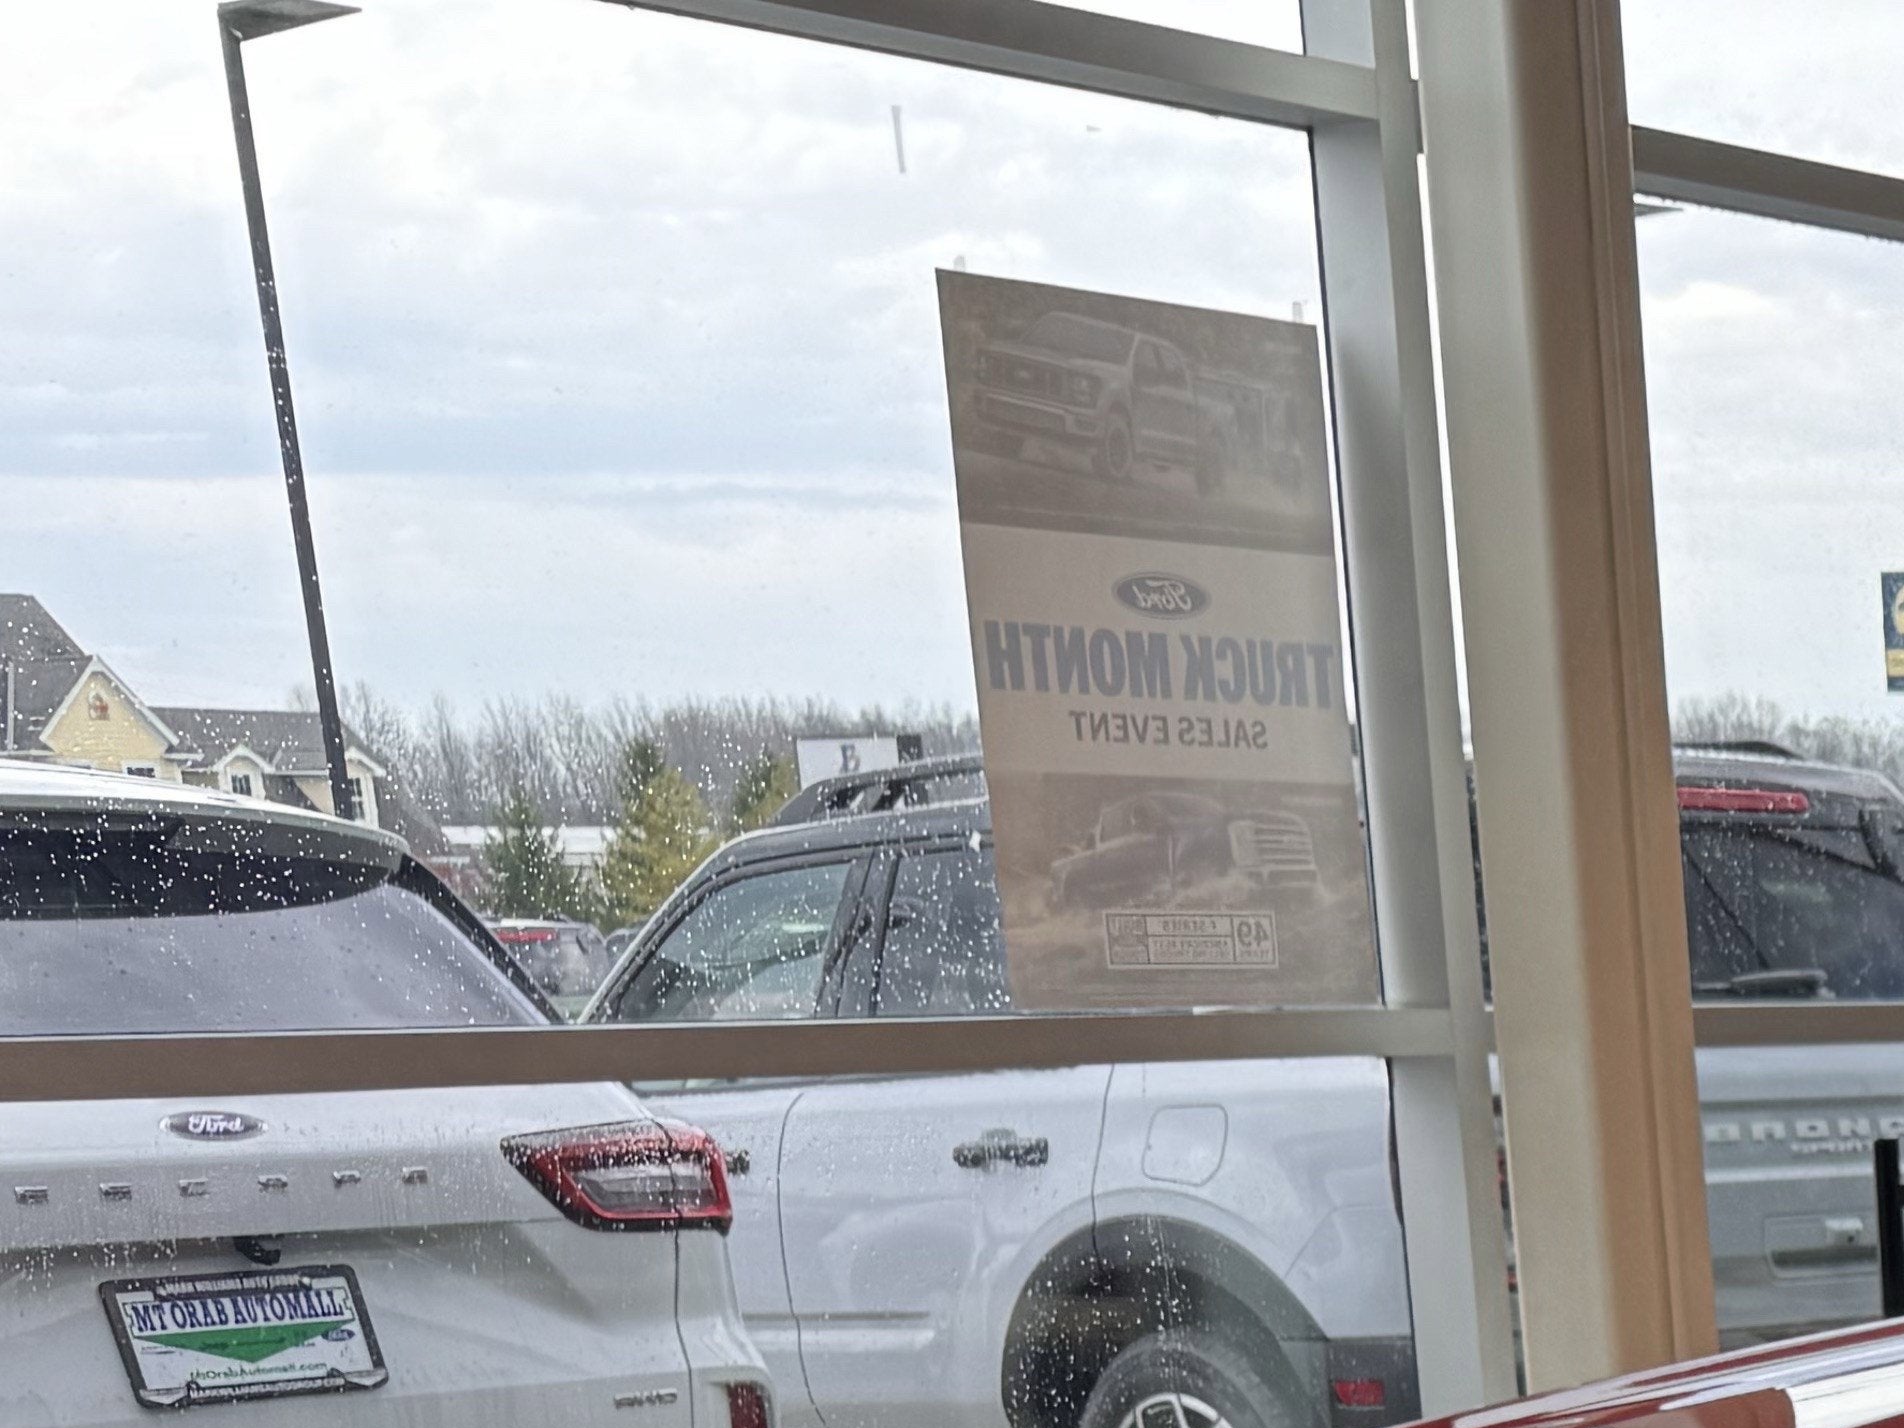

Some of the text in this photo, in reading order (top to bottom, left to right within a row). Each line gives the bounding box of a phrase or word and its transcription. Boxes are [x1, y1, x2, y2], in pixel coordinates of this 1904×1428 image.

[187, 1113, 246, 1134] Ford
[131, 1288, 345, 1333] MT ORAB AUTOMALL
